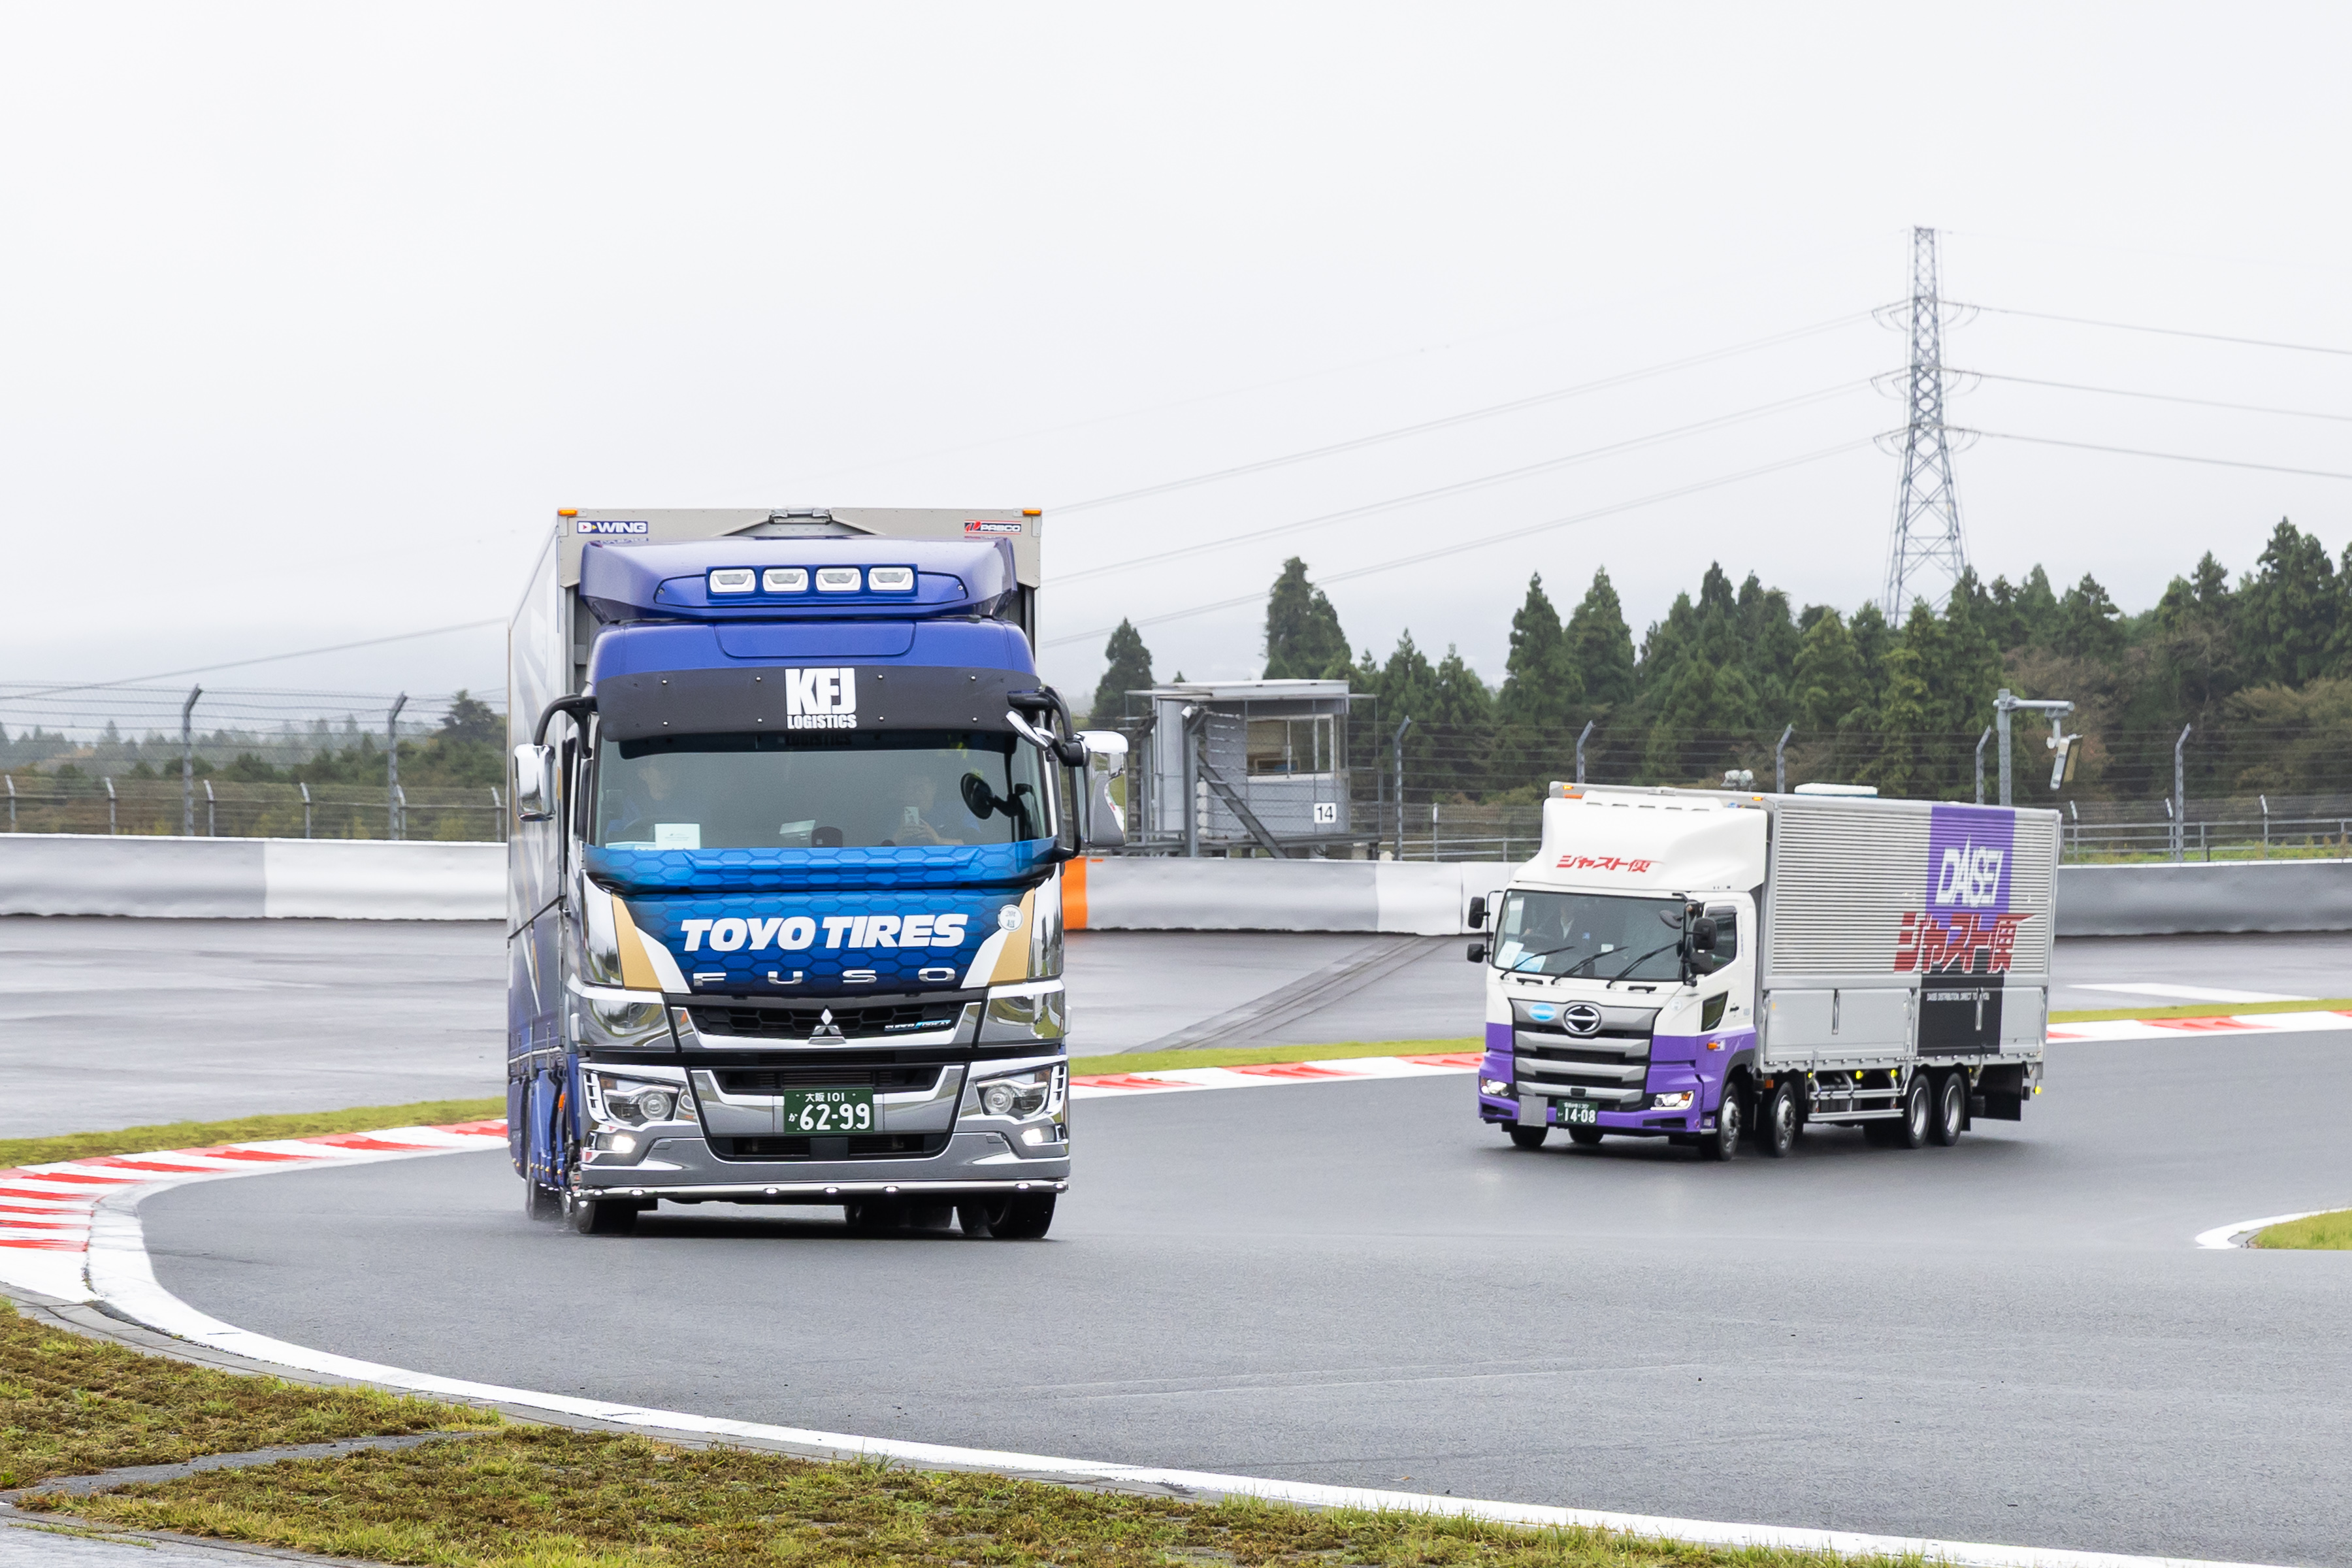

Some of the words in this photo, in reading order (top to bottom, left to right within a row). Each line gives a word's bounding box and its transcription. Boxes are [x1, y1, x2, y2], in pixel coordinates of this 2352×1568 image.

[785, 668, 856, 715] KFJ
[787, 714, 857, 729] LOGISTICS
[1316, 806, 1333, 821] 14
[1556, 855, 1663, 873] ジャスト便
[1935, 834, 2004, 907] DAISEI
[681, 916, 816, 951] TOYO
[822, 913, 968, 949] TIRES
[1893, 912, 2036, 973] ジャスト便
[693, 968, 955, 986] FUSO
[805, 1092, 825, 1102] 大阪
[827, 1092, 845, 1102] 101
[788, 1113, 798, 1122] か
[800, 1103, 870, 1130] 62-99
